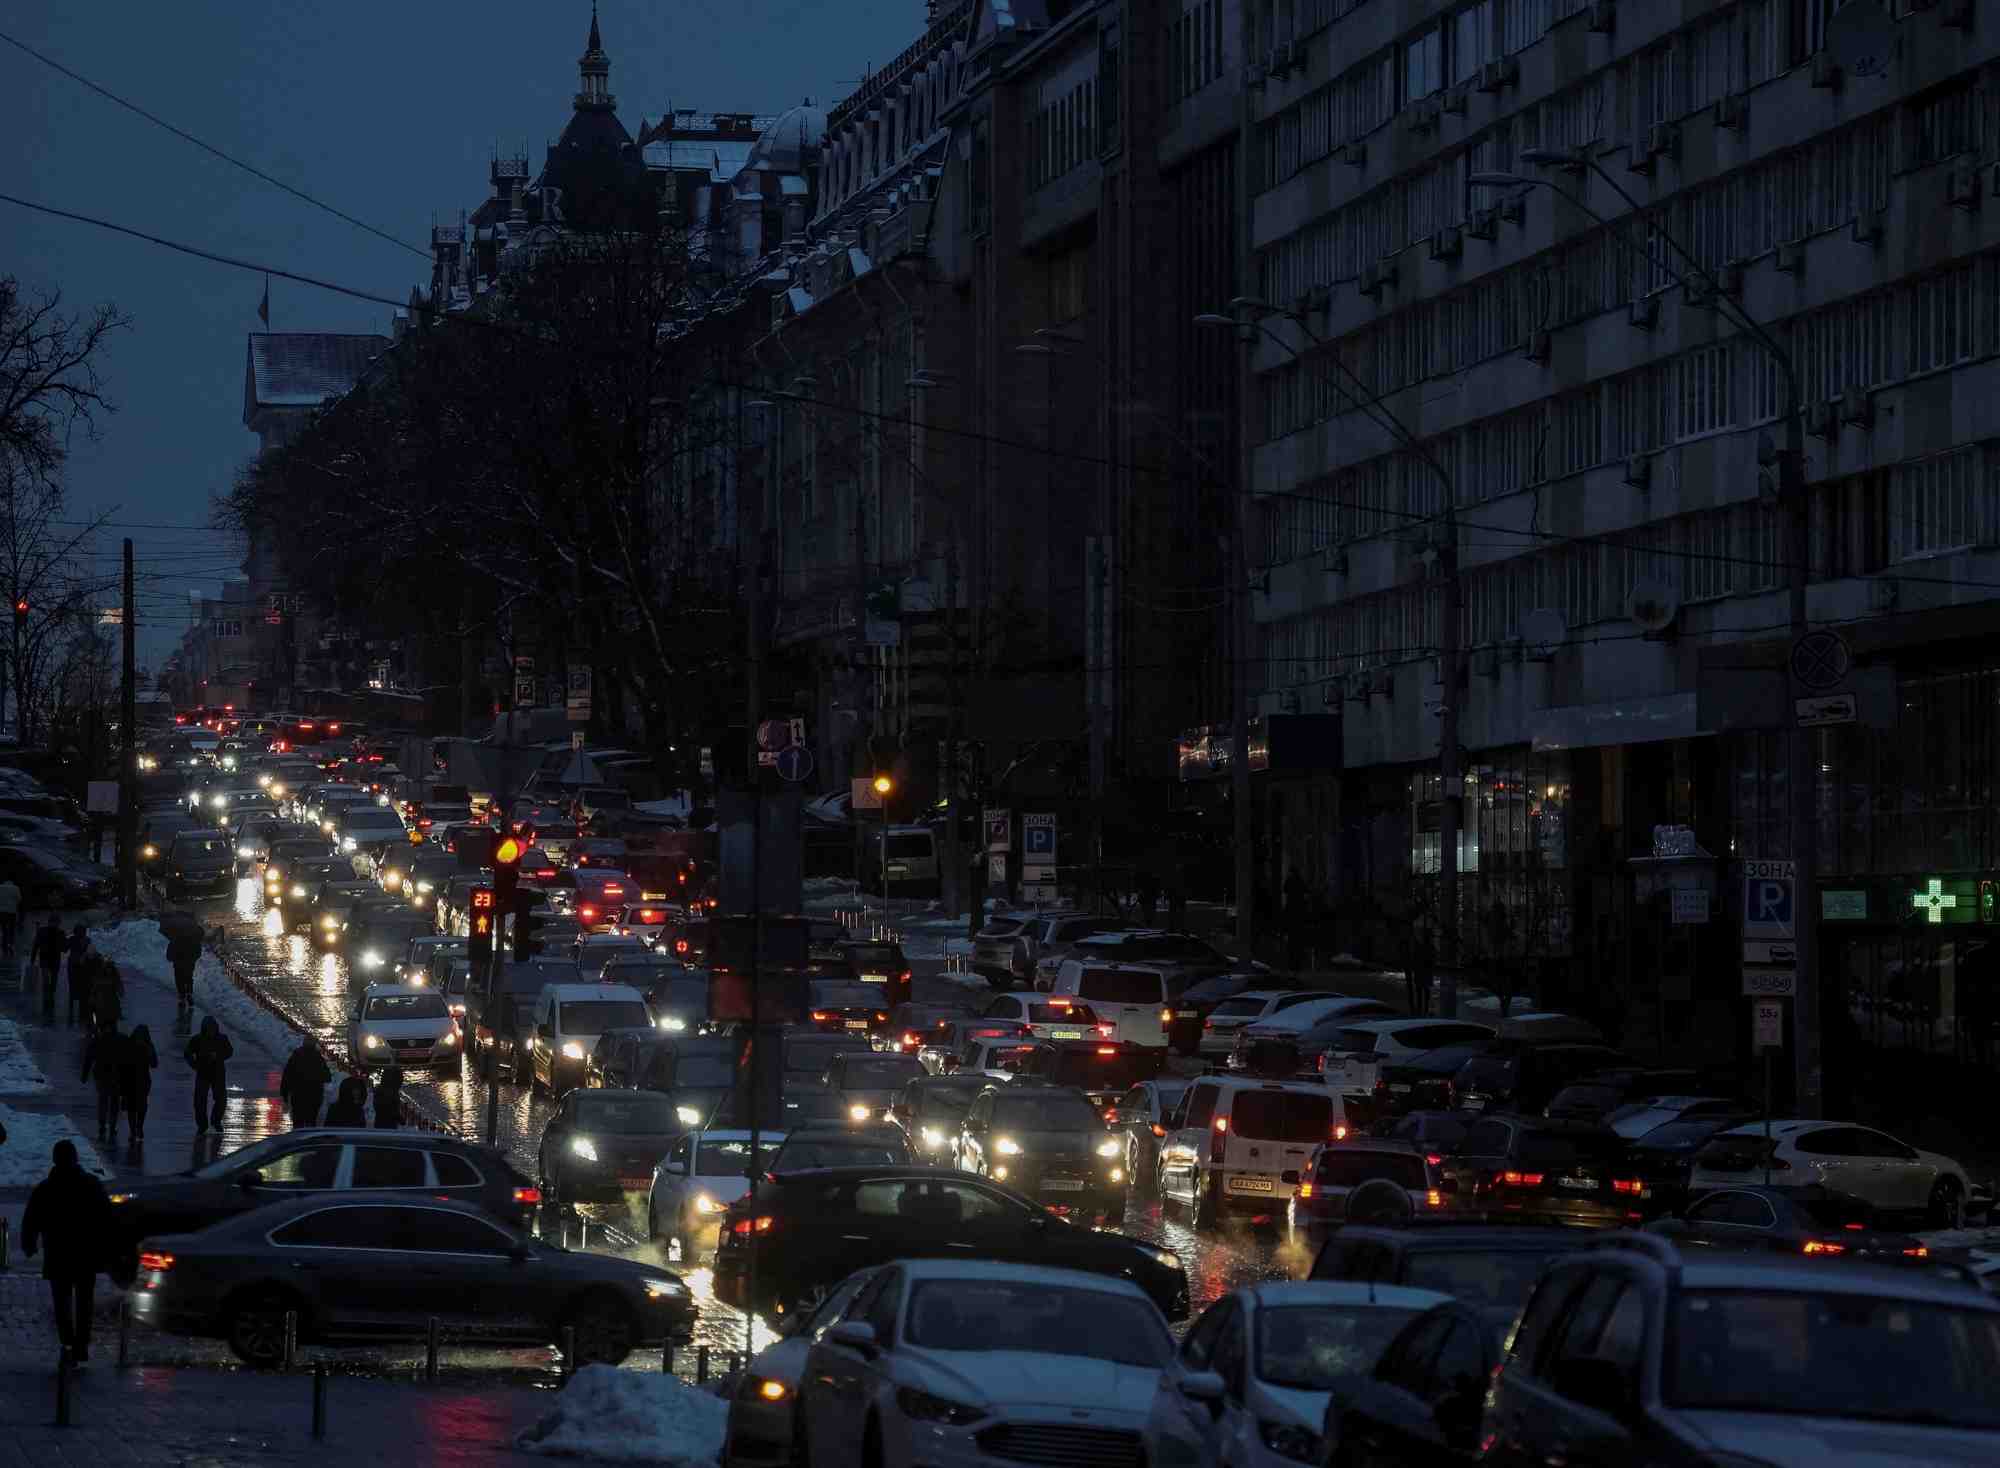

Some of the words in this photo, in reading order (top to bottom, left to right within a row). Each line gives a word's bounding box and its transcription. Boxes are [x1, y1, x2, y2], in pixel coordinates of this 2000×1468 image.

[1033, 832, 1046, 850] P
[1744, 863, 1794, 878] ЗОНА
[474, 893, 490, 907] 23
[1760, 882, 1784, 919] P
